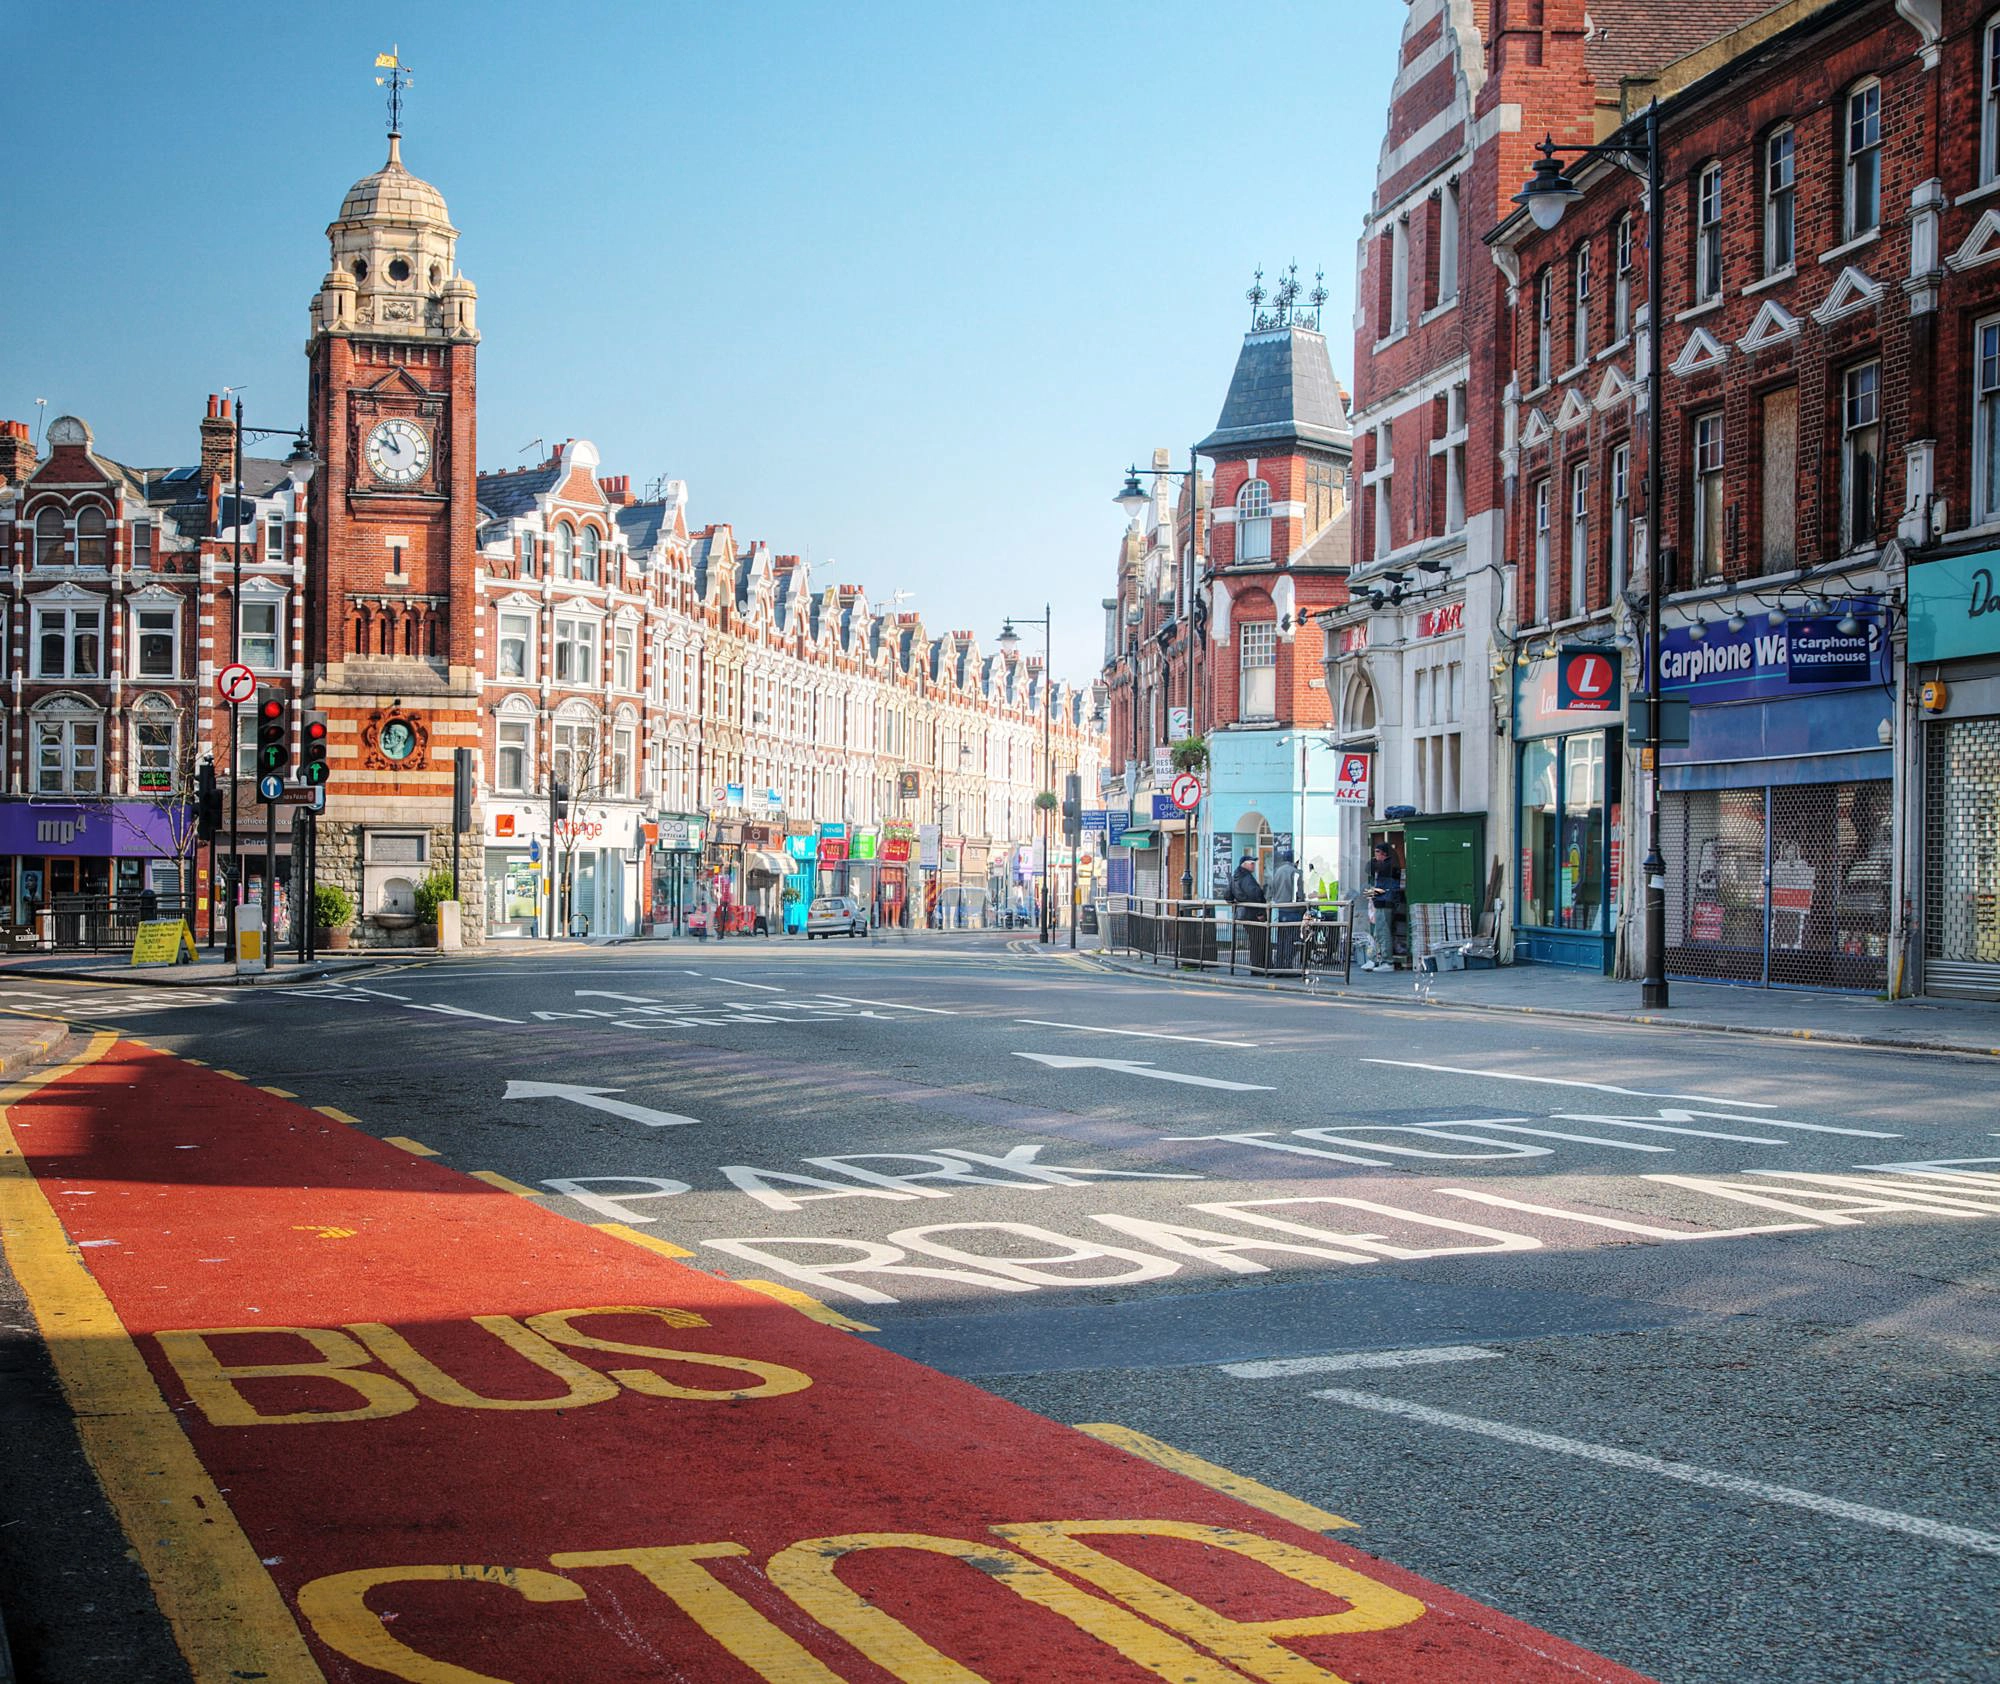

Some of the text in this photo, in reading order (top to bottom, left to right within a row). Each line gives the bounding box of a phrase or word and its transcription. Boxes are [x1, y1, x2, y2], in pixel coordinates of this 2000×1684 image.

[1798, 636, 1866, 649] Carphone
[1660, 642, 1752, 682] Carphone
[1792, 651, 1867, 664] Warehouse
[1578, 658, 1600, 692] L
[1569, 701, 1601, 710] Ladbrokes
[1336, 788, 1366, 799] KFC
[1161, 811, 1183, 819] SHOP
[553, 819, 603, 841] Orange
[10, 991, 208, 1010] AHEAD
[63, 997, 237, 1014] ONLY
[530, 1001, 852, 1020] AHEAD
[611, 1010, 895, 1029] ONLY
[541, 1145, 1206, 1224] PARK
[701, 1197, 1544, 1305] ROAD
[153, 1305, 814, 1427] BUS
